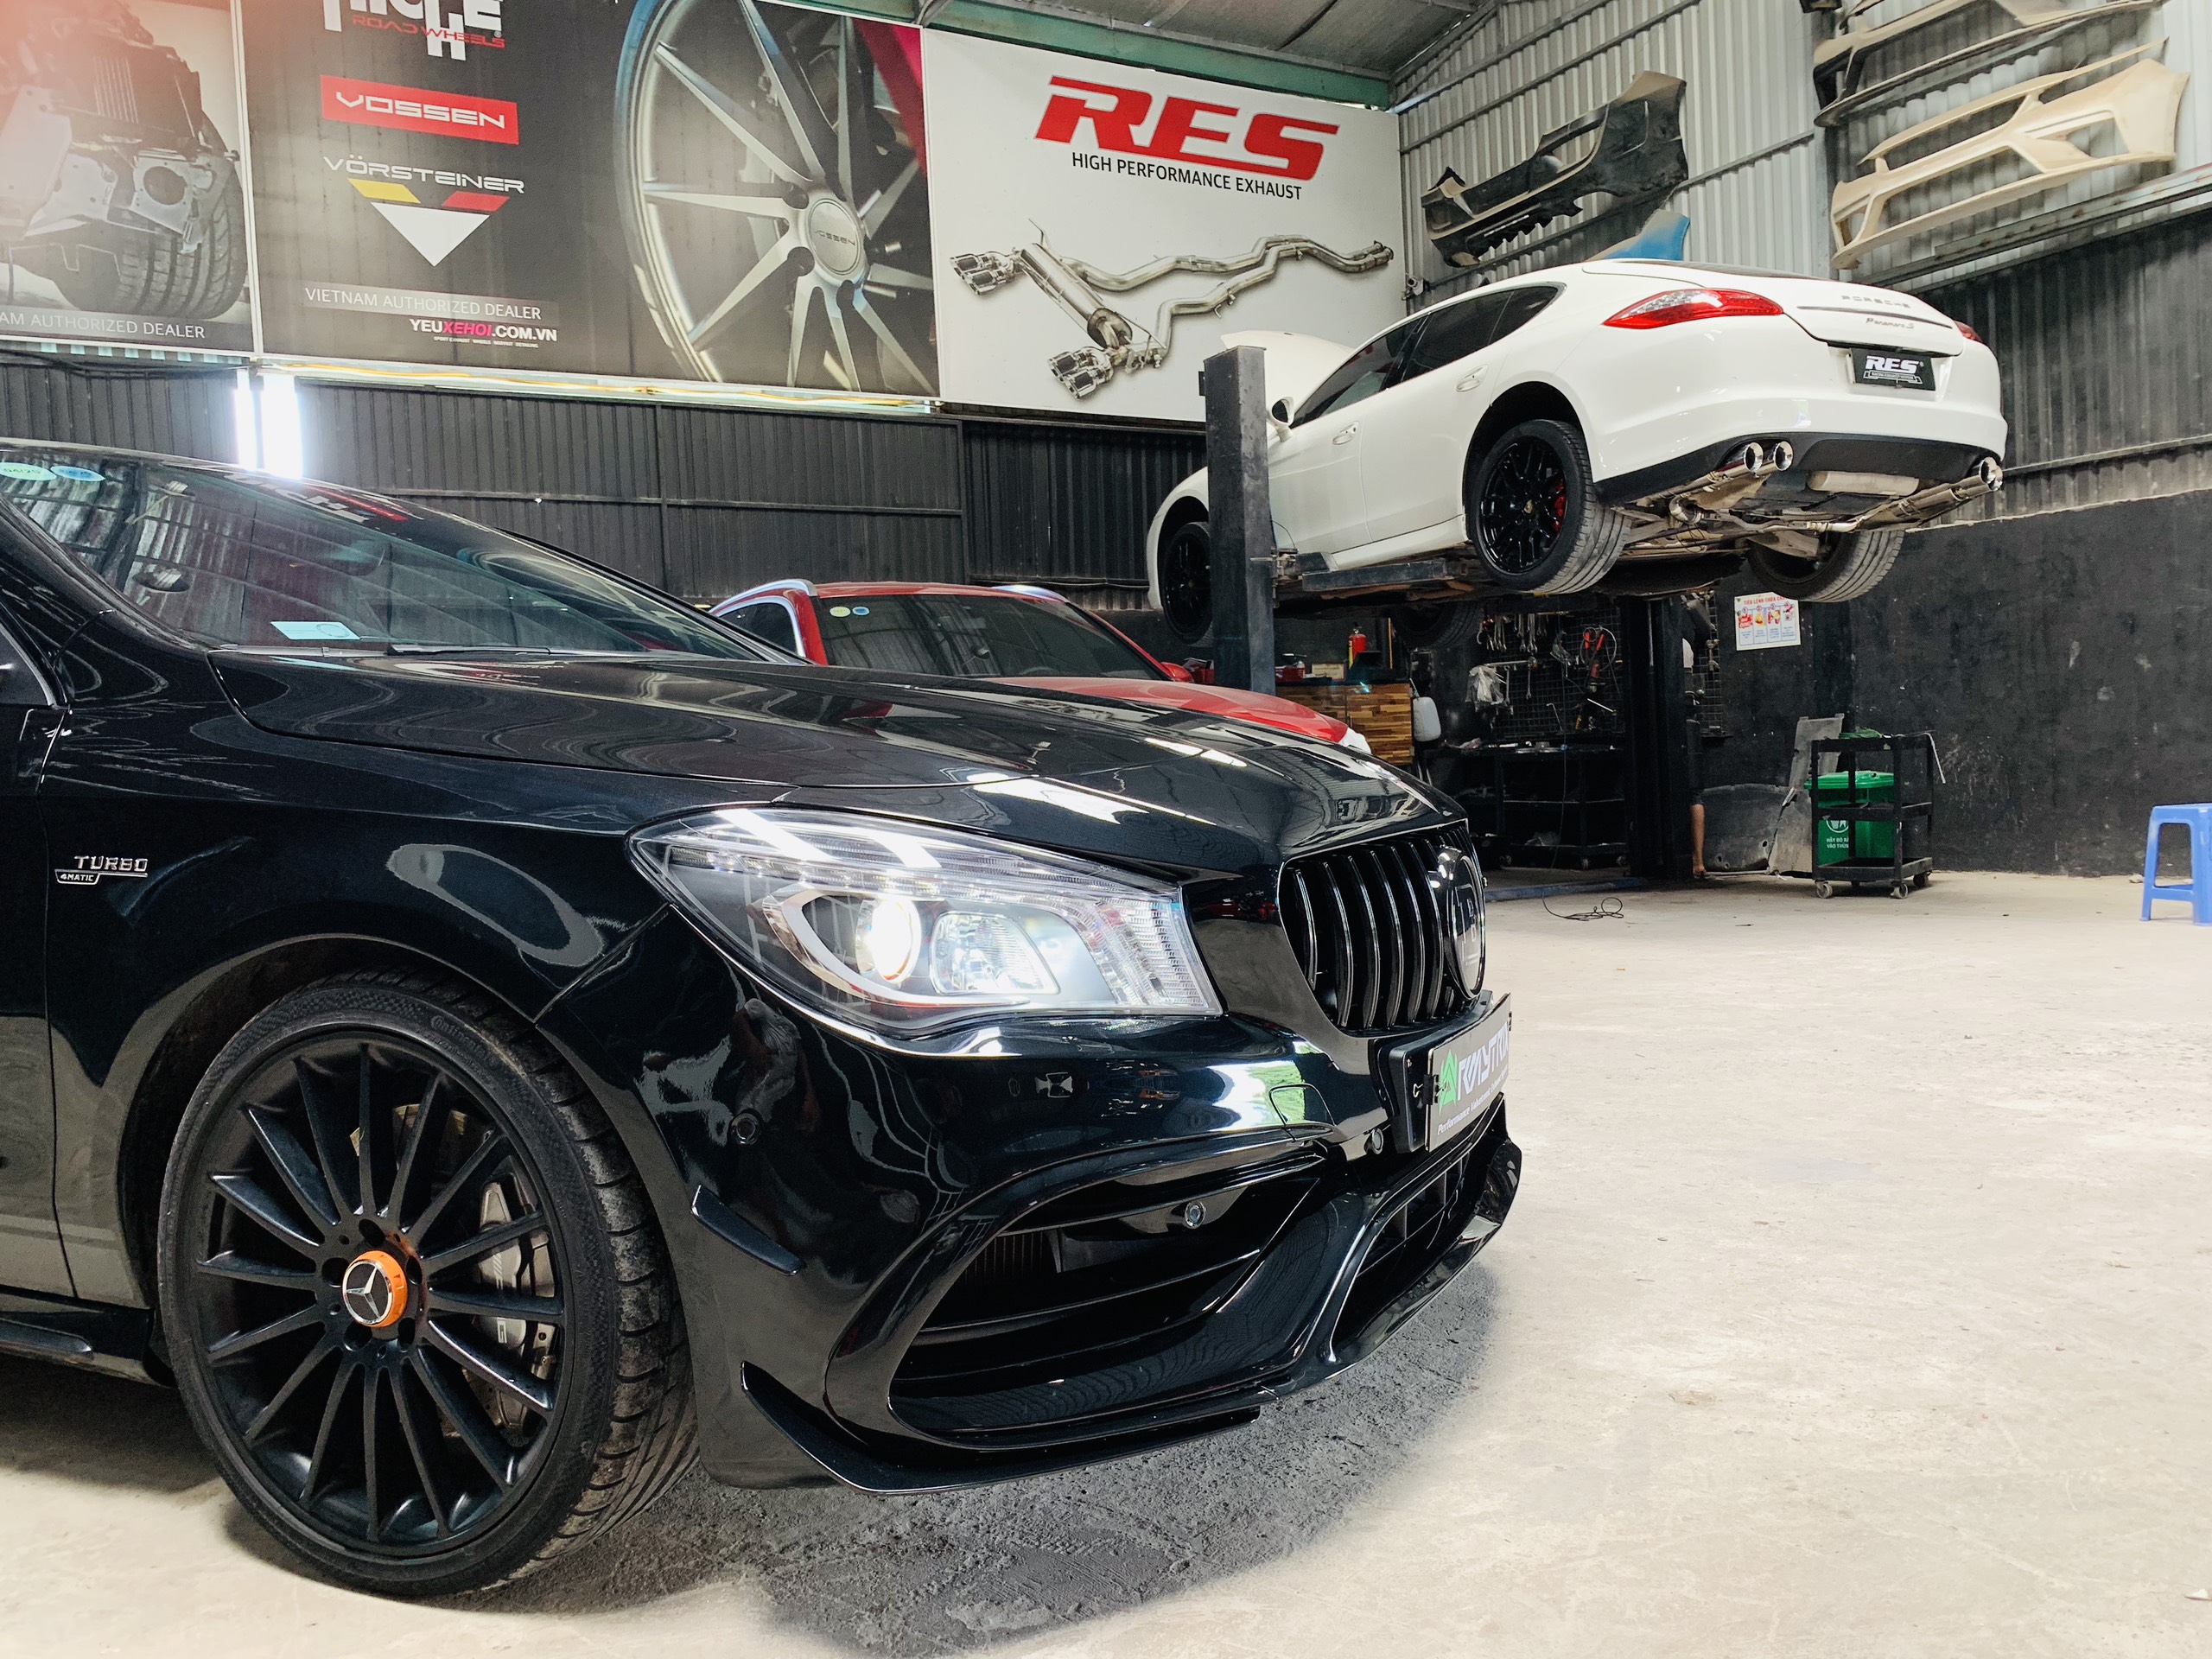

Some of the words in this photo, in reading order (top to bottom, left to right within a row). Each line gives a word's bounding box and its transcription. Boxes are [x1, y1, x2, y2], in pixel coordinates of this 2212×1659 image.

[353, 14, 418, 35] ROAD
[421, 27, 505, 48] WHEELS
[335, 92, 505, 130] VOSSEN
[1033, 75, 1340, 181] RES
[323, 154, 525, 194] VÖRSTEINER
[1071, 151, 1112, 173] HIGH
[1117, 159, 1232, 191] PERFORMANCE
[1236, 176, 1303, 200] EXHAUST
[304, 287, 378, 307] VIETNAM
[383, 294, 480, 315] AUTHORIZED
[485, 303, 542, 320] DEALER
[30, 314, 138, 334] AUTHORIZED
[143, 321, 207, 340] DEALER
[409, 318, 558, 342] YEUXEHOI.COM.VN
[1865, 355, 1920, 374] RES
[60, 874, 94, 882] 4MATIC
[73, 855, 149, 872] TURBO
